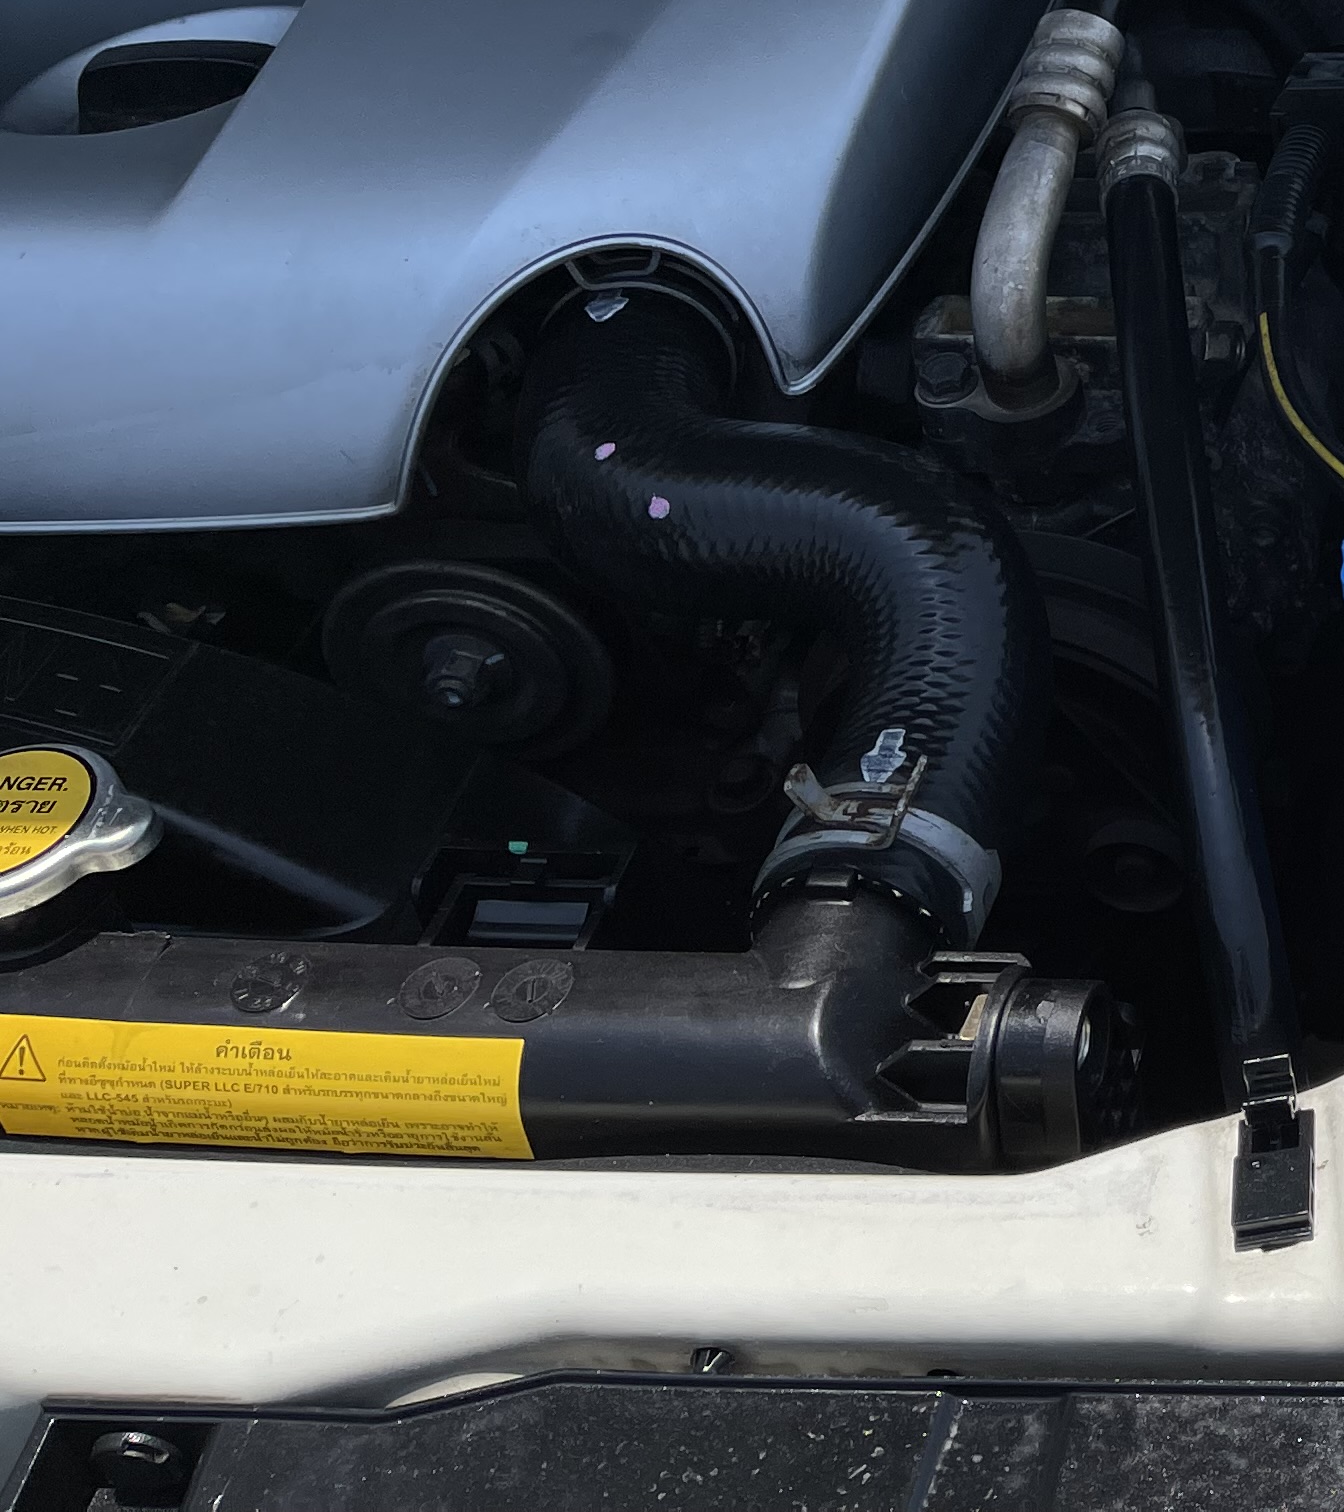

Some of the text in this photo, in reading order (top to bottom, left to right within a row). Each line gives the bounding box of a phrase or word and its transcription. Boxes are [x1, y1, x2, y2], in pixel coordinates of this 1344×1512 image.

[215, 1039, 292, 1062] คำเตือน
[160, 1079, 211, 1092] (SUPER
[214, 1081, 241, 1094] LLC
[243, 1083, 279, 1095] E/710
[86, 1091, 139, 1103] LLC-545
